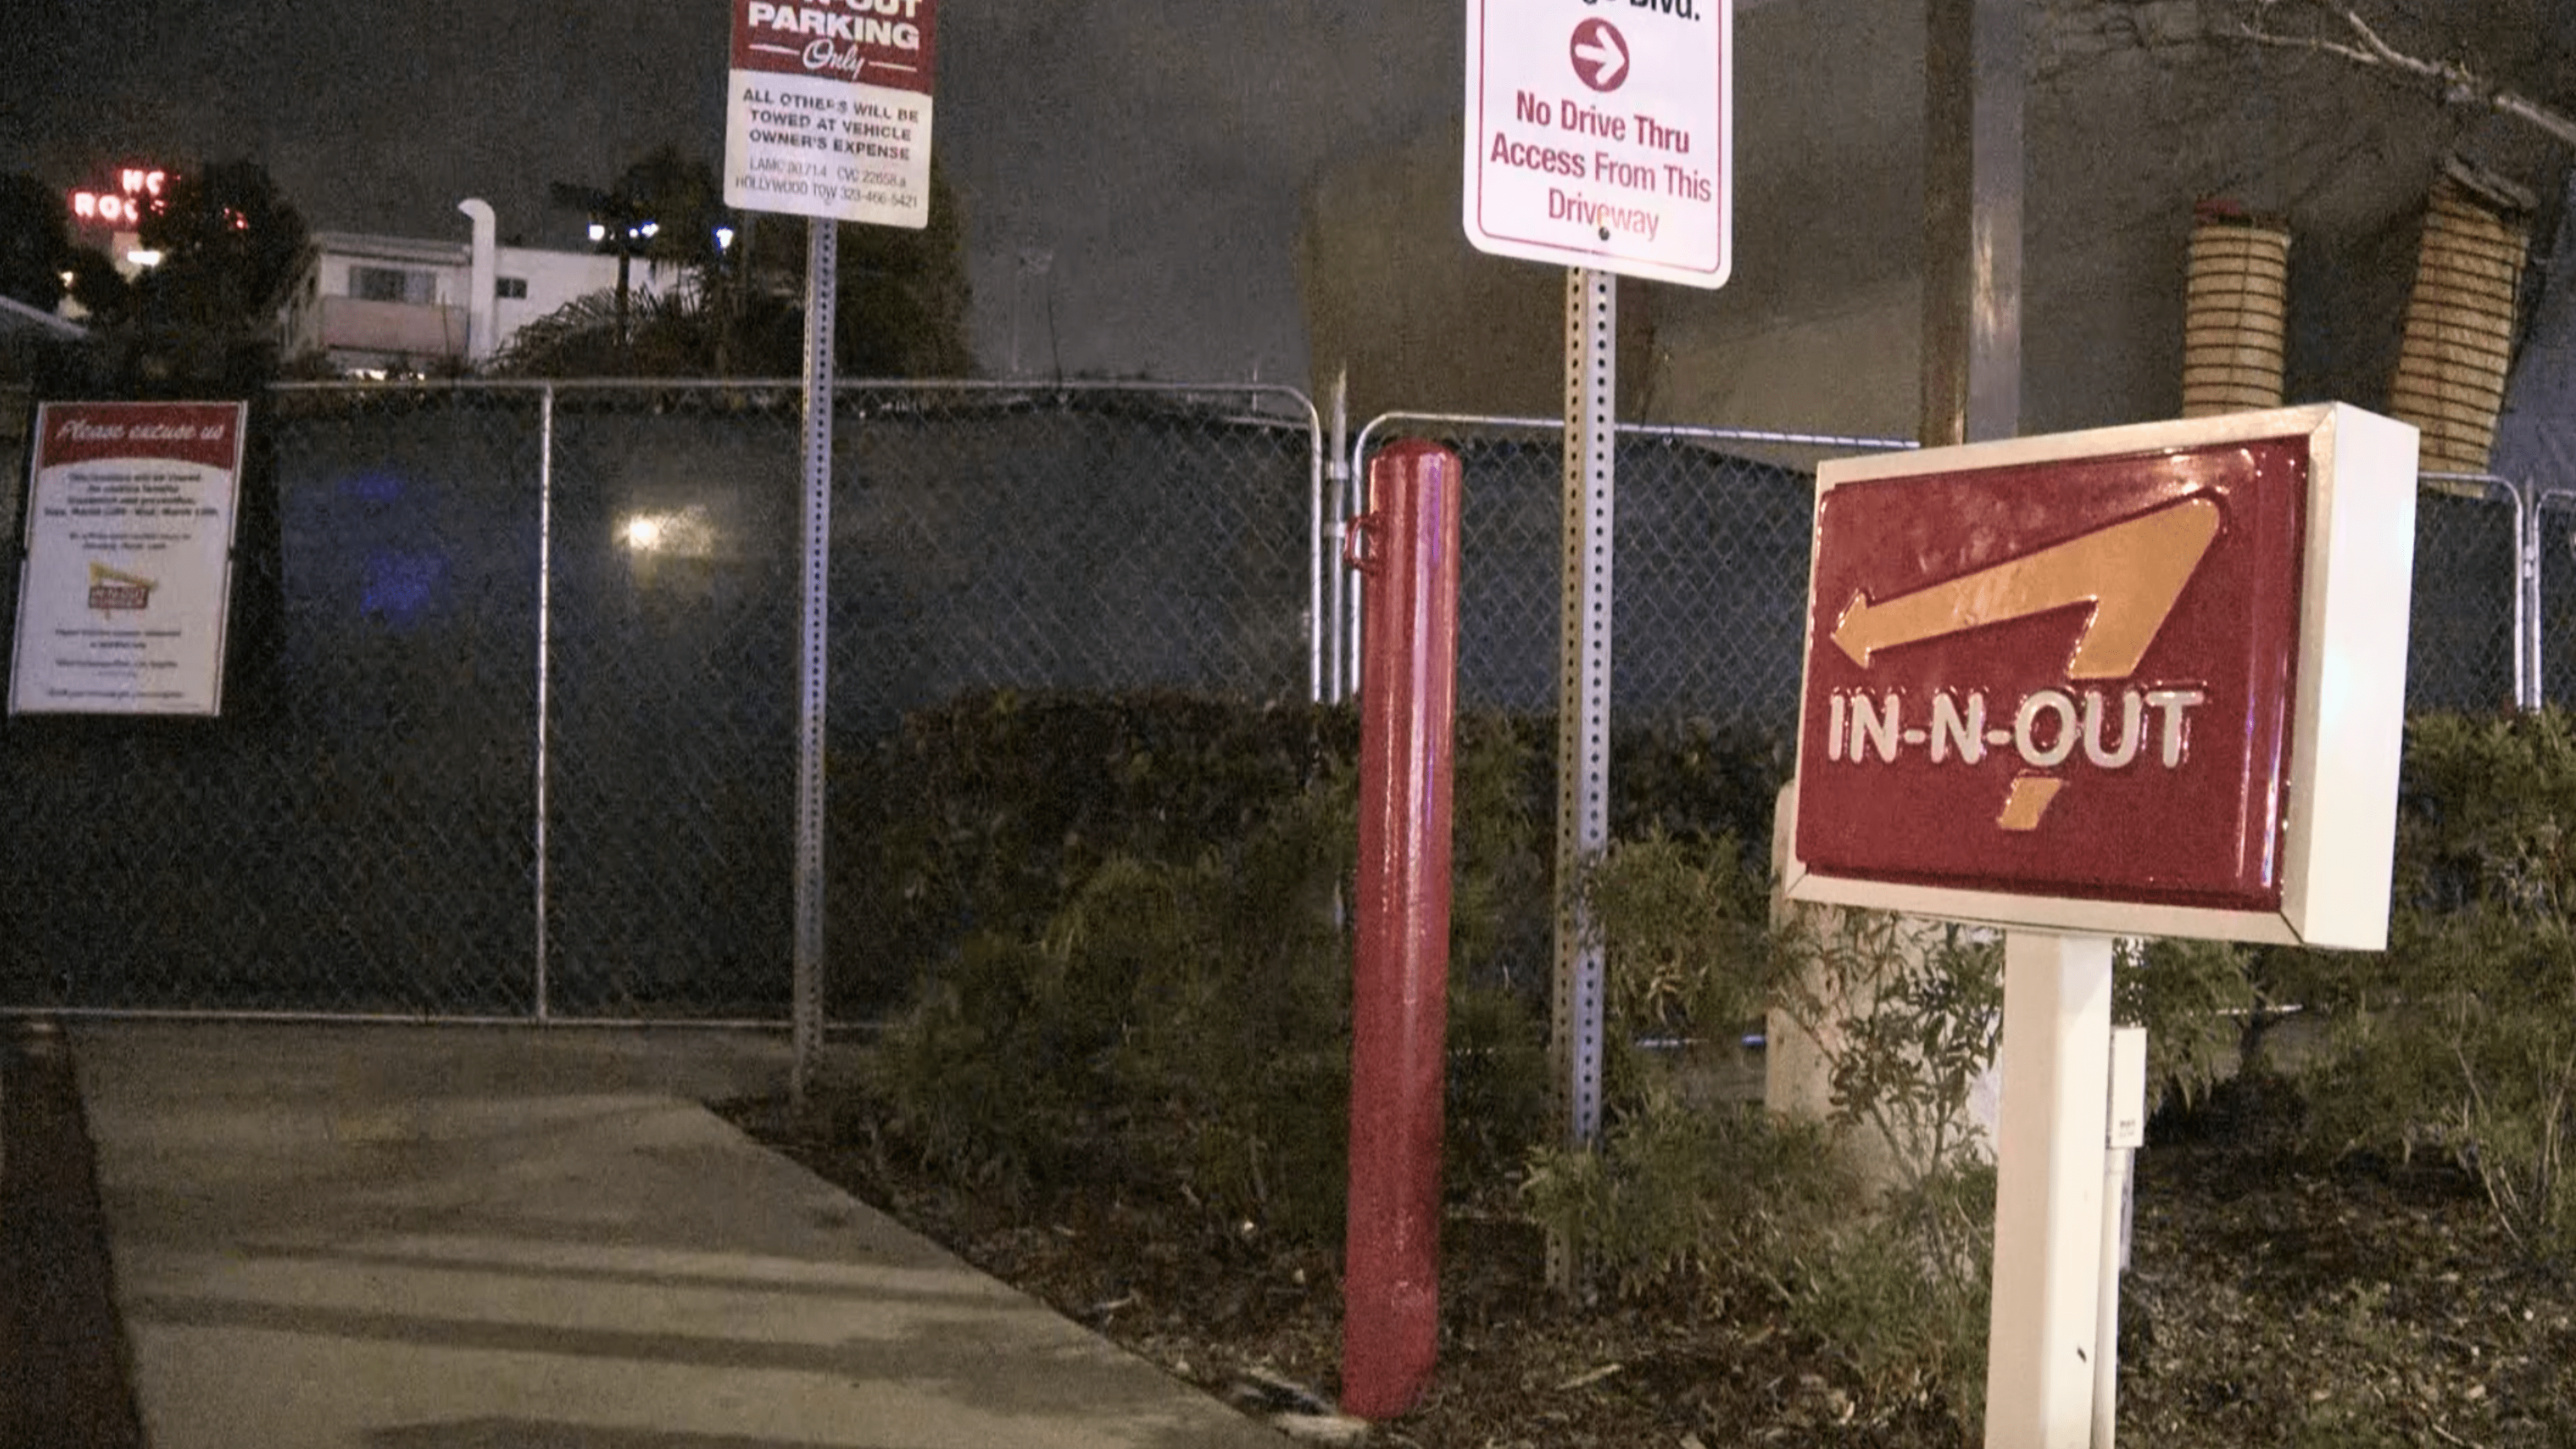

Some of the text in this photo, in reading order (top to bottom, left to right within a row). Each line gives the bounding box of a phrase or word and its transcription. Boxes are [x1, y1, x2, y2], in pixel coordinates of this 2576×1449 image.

[749, 1, 920, 50] PARKING
[803, 39, 865, 80] Only
[743, 88, 919, 124] ALL OTHERS WILL BE
[750, 109, 912, 142] TOWED AT VEHICLE
[1516, 90, 1689, 154] No Drive Thru
[749, 128, 910, 160] OWNER'S EXPENSE
[1491, 131, 1711, 202] Access From This
[1549, 187, 1660, 242] Driveway
[55, 419, 126, 440] Please
[200, 424, 224, 440] us
[1828, 689, 2204, 768] IN-N-OUT
